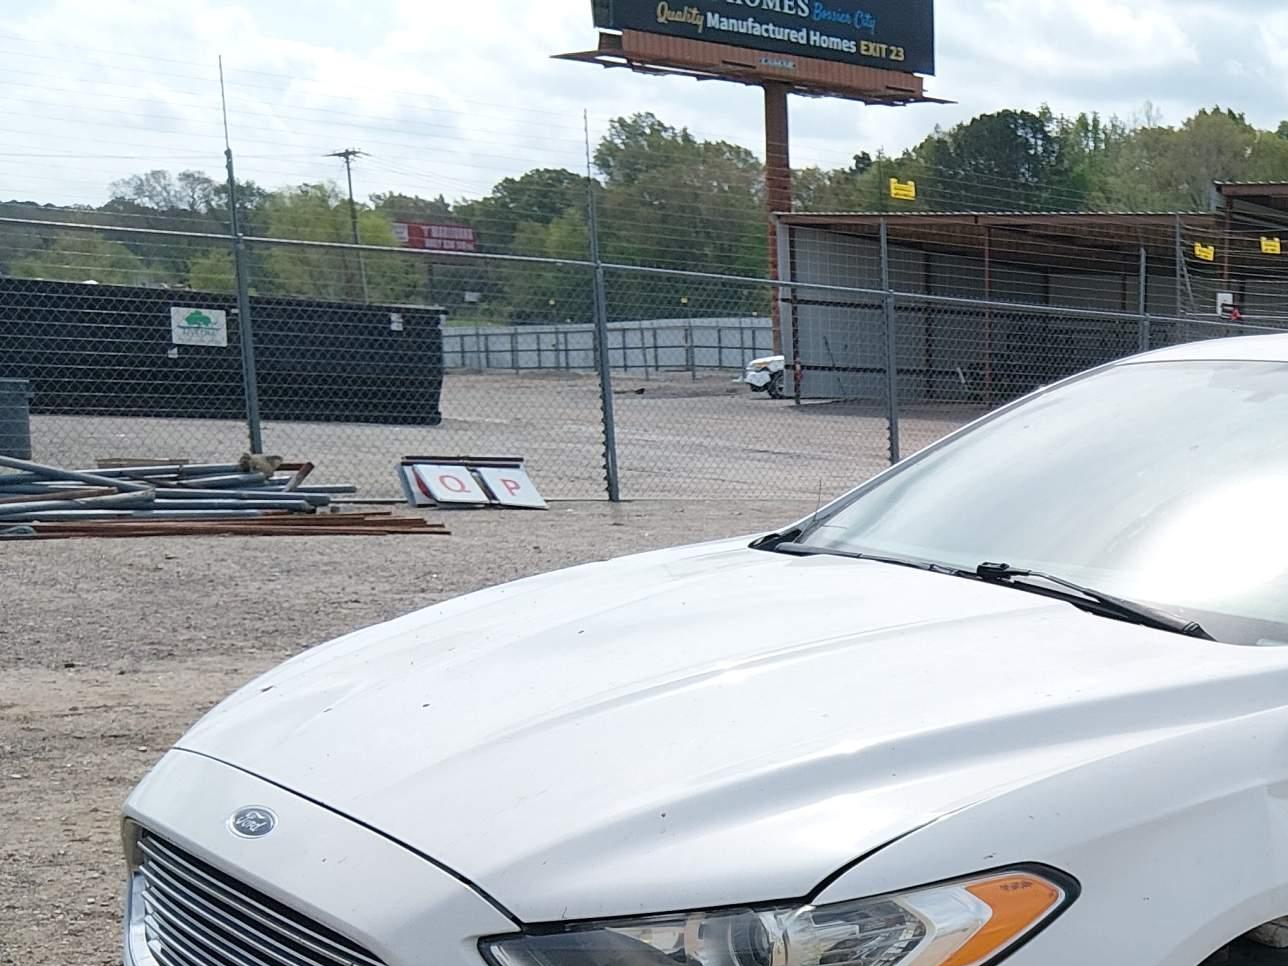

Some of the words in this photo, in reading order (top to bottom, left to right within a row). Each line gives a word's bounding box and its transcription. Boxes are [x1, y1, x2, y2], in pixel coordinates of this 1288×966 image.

[656, 1, 705, 33] Quality
[706, 12, 807, 45] Manufactured
[809, 30, 857, 53] Homes
[859, 40, 889, 60] EXIT
[889, 46, 905, 62] 23
[854, 10, 877, 35] City
[439, 475, 471, 493] Q
[501, 479, 521, 496] P
[235, 811, 267, 832] Ford
